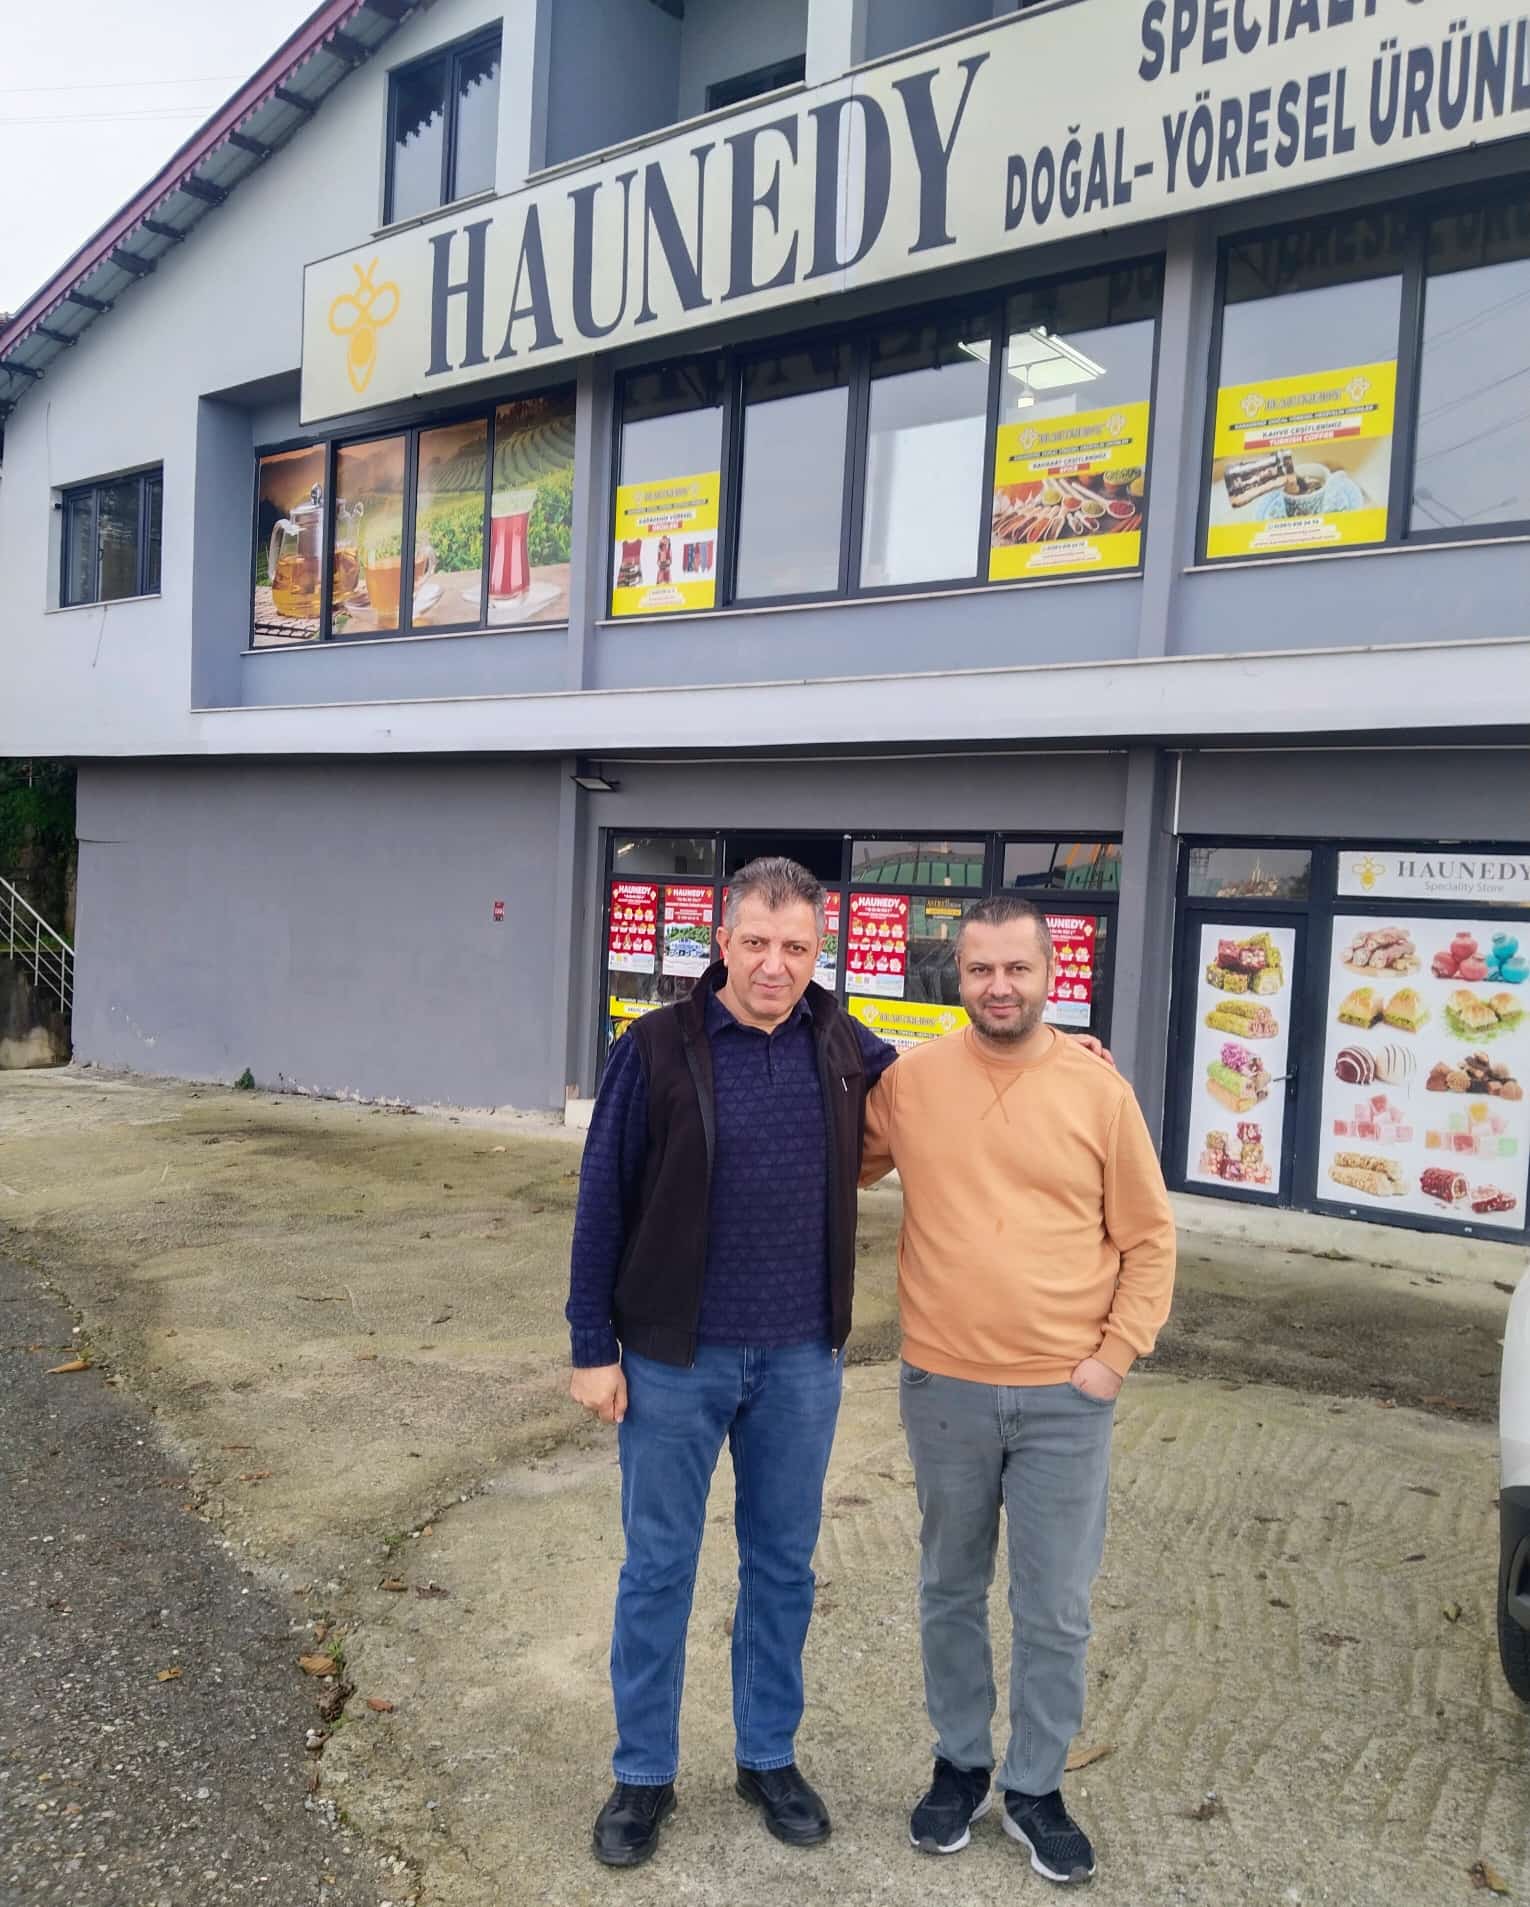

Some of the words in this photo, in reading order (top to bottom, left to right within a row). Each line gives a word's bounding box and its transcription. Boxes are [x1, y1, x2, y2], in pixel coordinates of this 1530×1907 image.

[424, 52, 991, 377] HAUNEDY
[1397, 860, 1530, 881] HAUNEDY
[1476, 883, 1504, 893] Store
[858, 896, 901, 908] HAUNEDY
